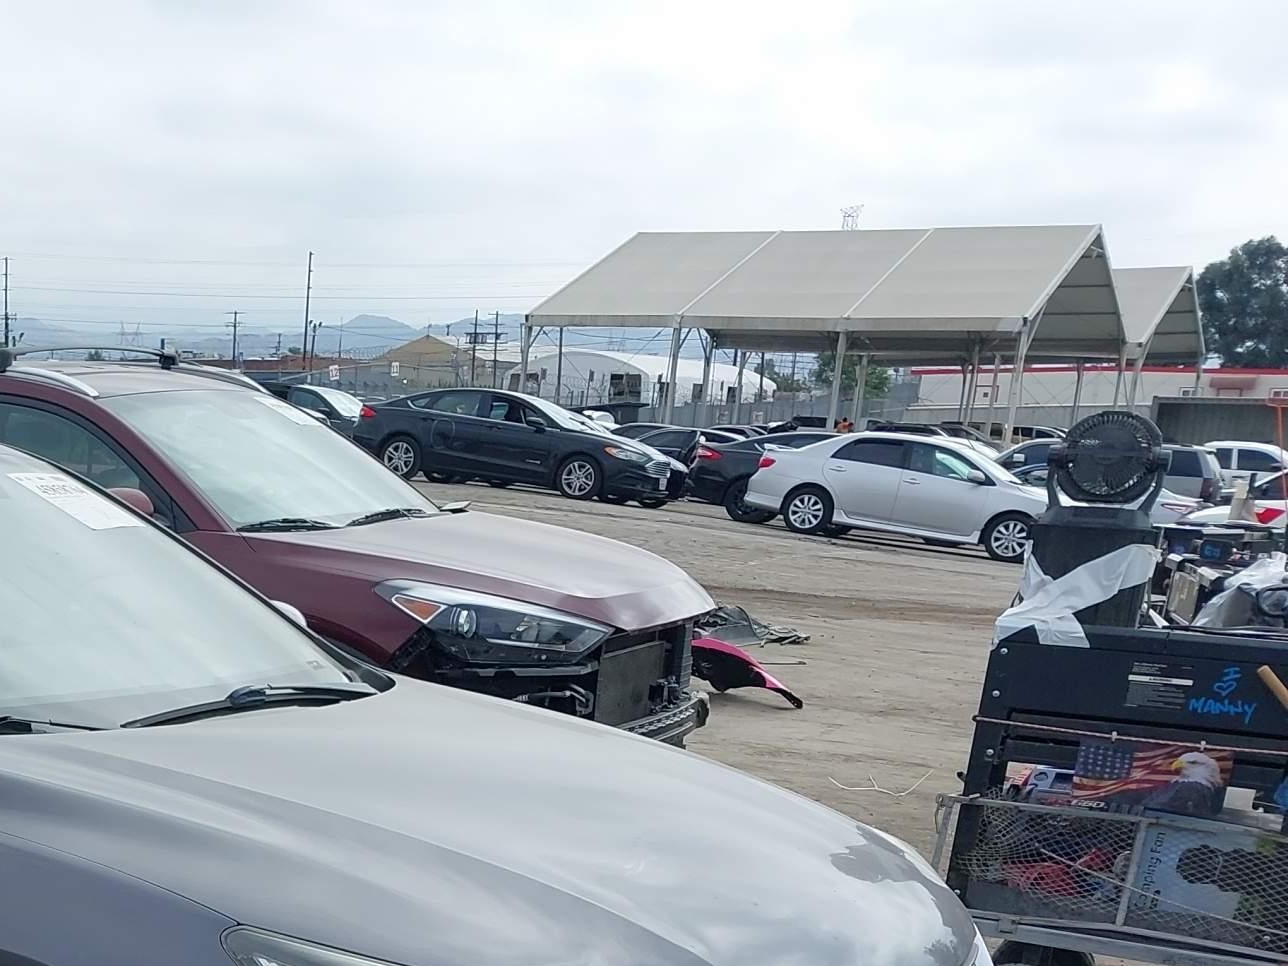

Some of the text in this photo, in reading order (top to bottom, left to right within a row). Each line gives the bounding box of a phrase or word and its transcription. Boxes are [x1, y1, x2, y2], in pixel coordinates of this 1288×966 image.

[1223, 666, 1242, 681] I
[1188, 697, 1257, 723] MANNY
[1150, 832, 1167, 854] Fan
